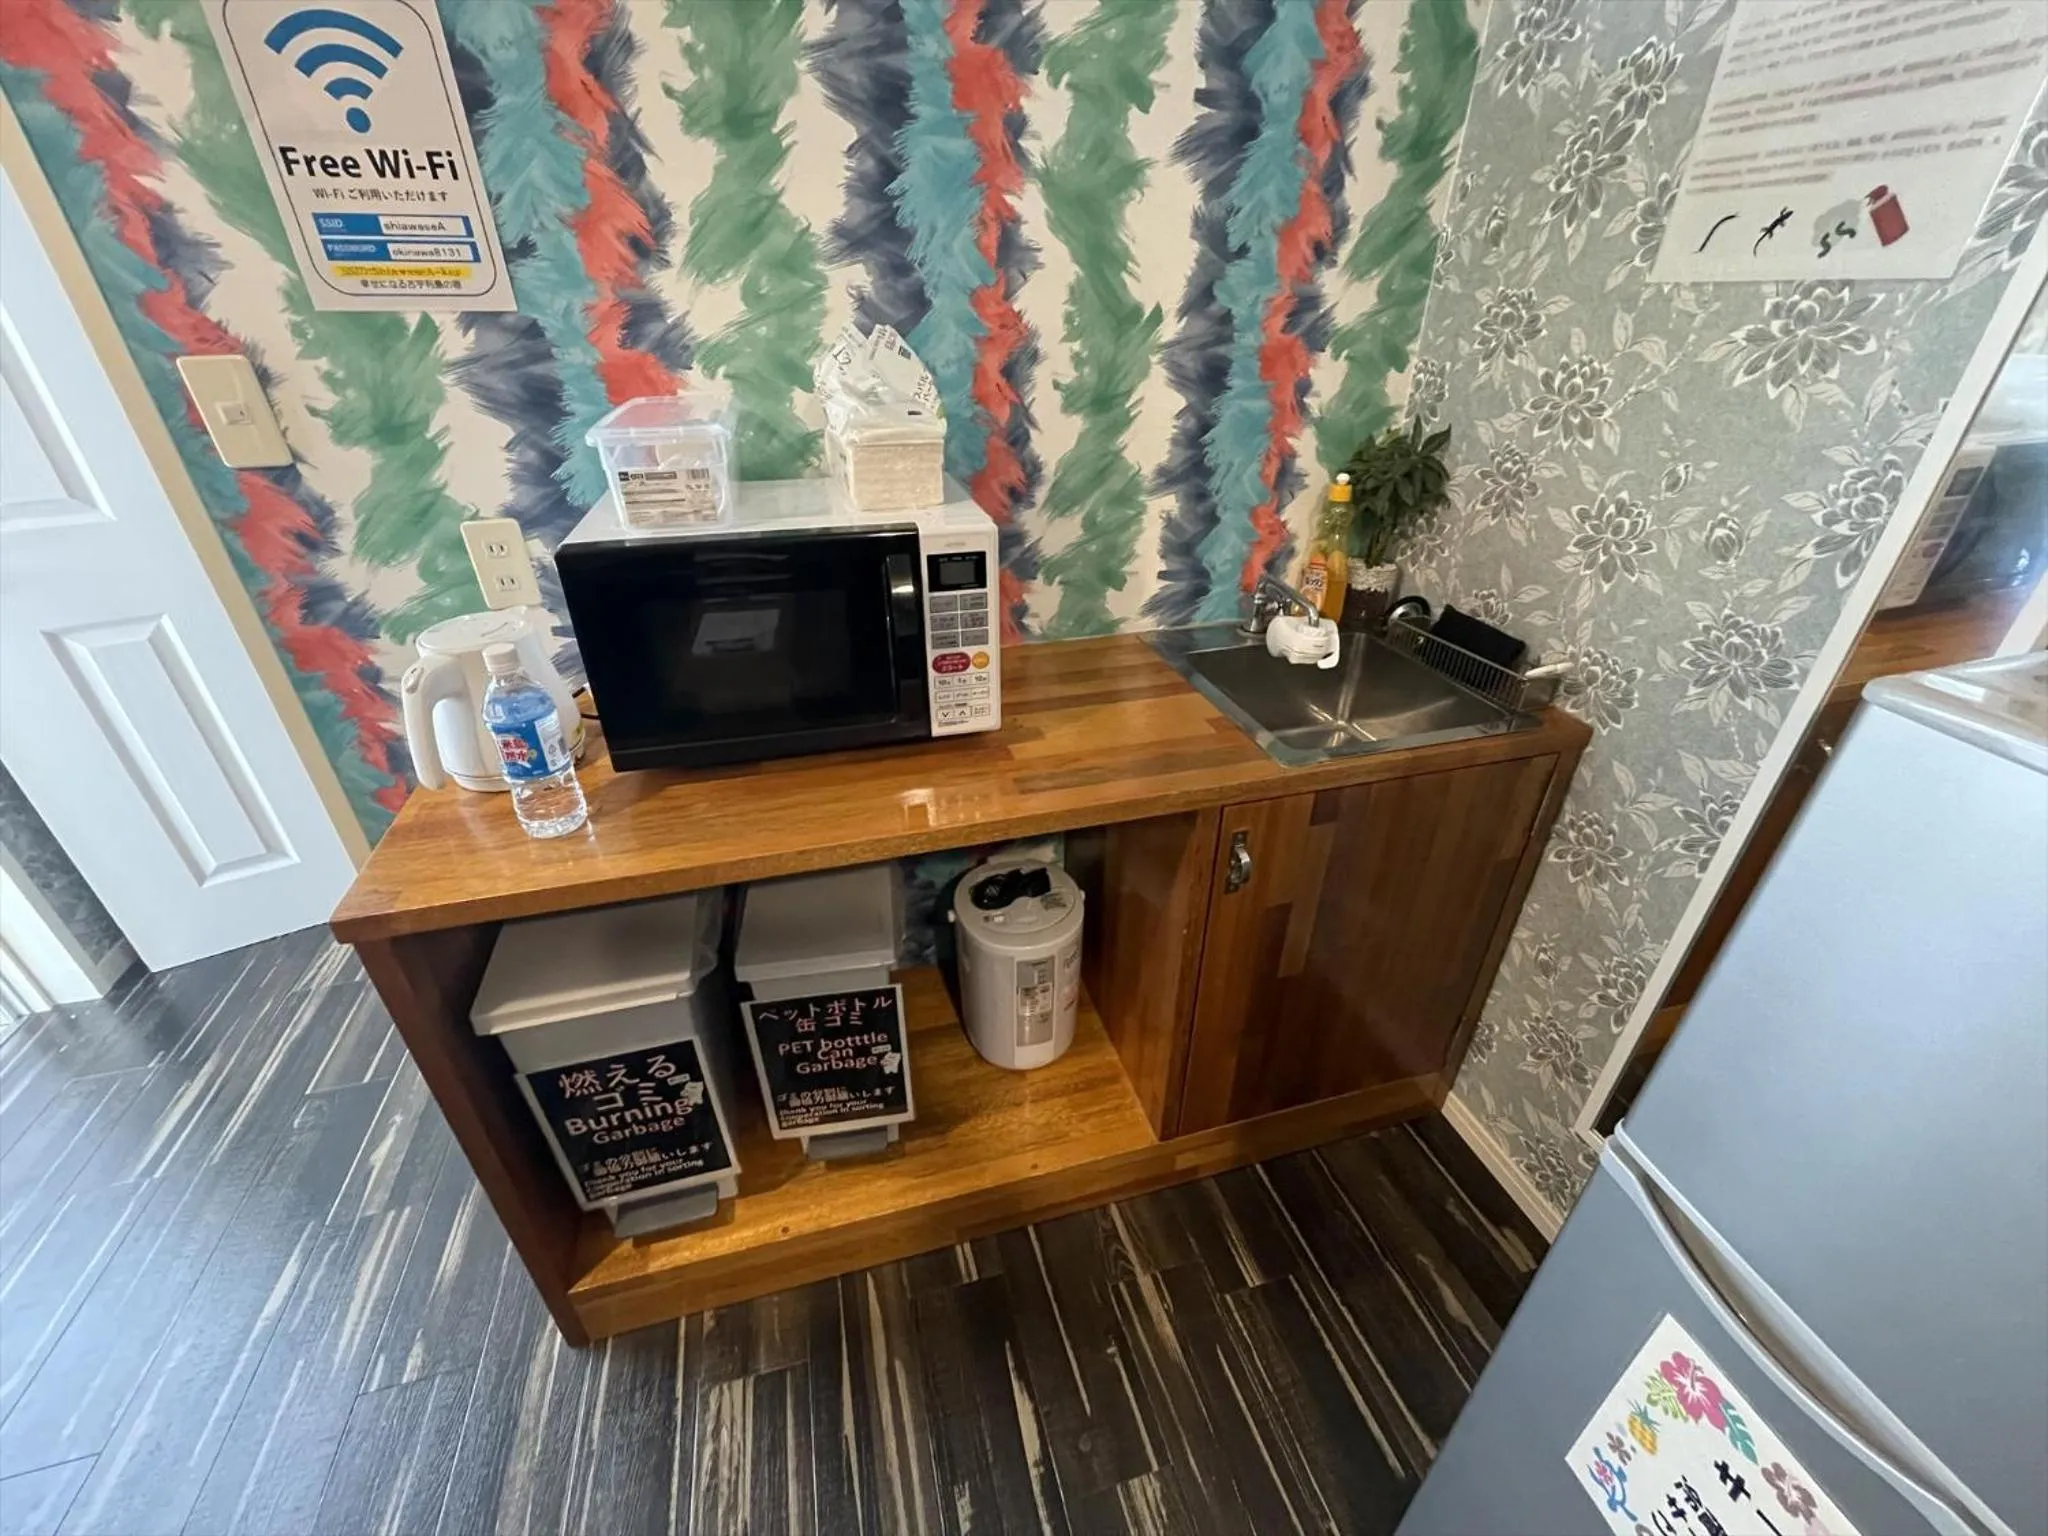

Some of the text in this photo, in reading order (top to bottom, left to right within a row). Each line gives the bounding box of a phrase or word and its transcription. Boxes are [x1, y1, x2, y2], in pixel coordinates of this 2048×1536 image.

[278, 146, 459, 181] Free Wi-Fi
[348, 189, 448, 202] ご利用いただけます
[319, 218, 344, 228] SSID
[759, 995, 893, 1020] ペットボトル
[795, 1011, 864, 1033] 缶ゴミ
[778, 1040, 814, 1057] PET
[817, 1046, 854, 1061] Can
[558, 1054, 676, 1099] 燃える
[796, 1055, 878, 1075] Garbage
[592, 1082, 663, 1111] ゴミ
[564, 1097, 694, 1136] Burning
[592, 1115, 686, 1145] Garbage
